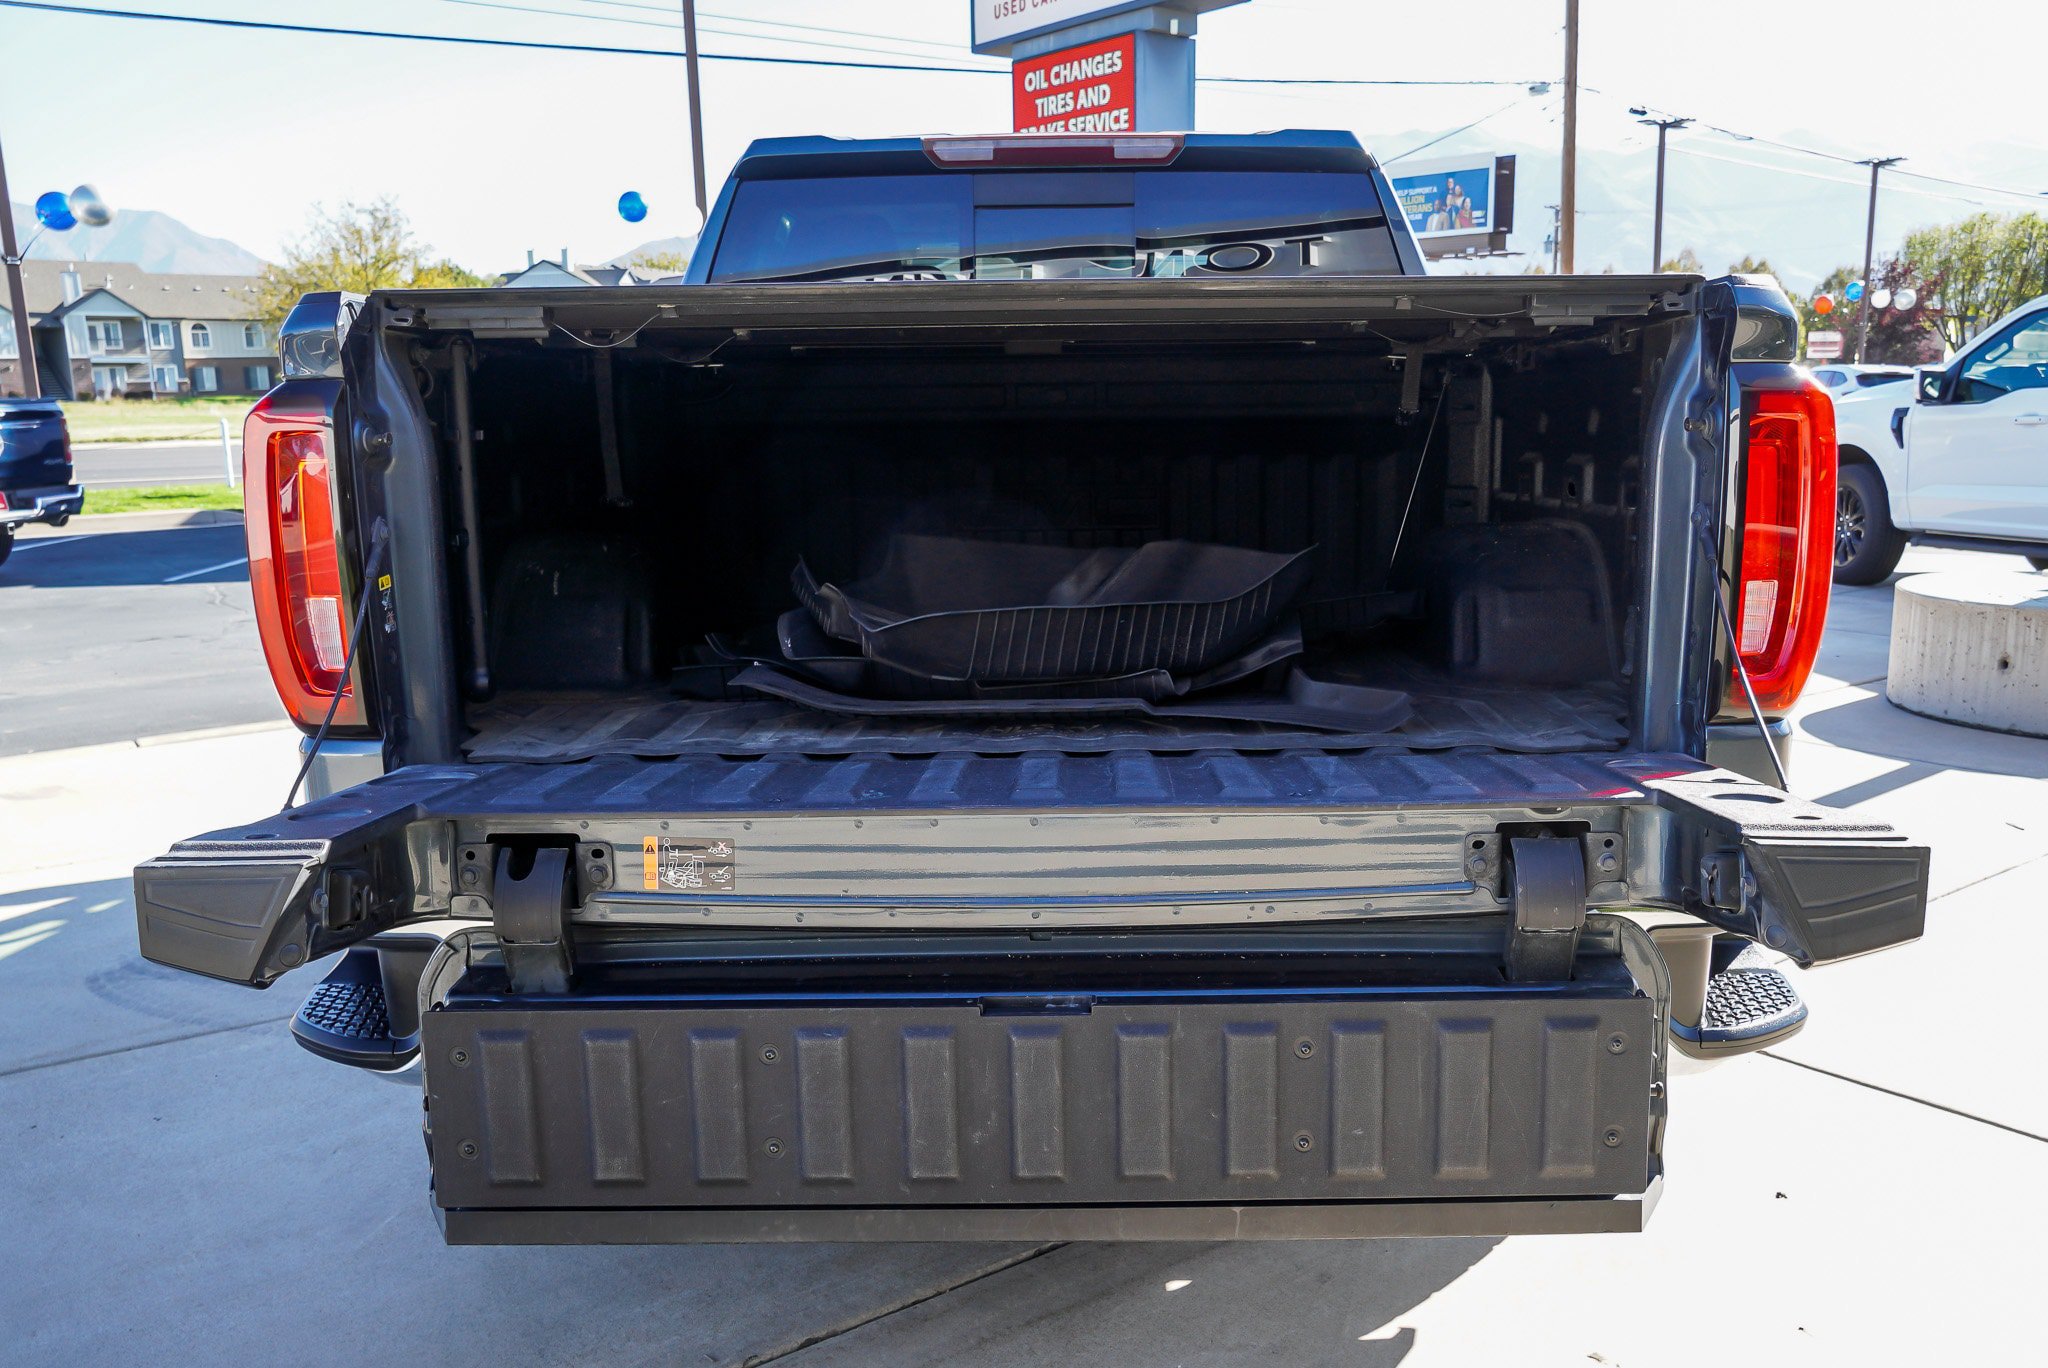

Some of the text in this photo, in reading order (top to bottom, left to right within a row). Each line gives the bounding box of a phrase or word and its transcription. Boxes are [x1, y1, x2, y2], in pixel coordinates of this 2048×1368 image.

[994, 0, 1026, 19] USED
[1024, 50, 1123, 92] OIL CHANGES
[1035, 83, 1110, 118] TIRES AND
[1068, 107, 1129, 133] SERVICE
